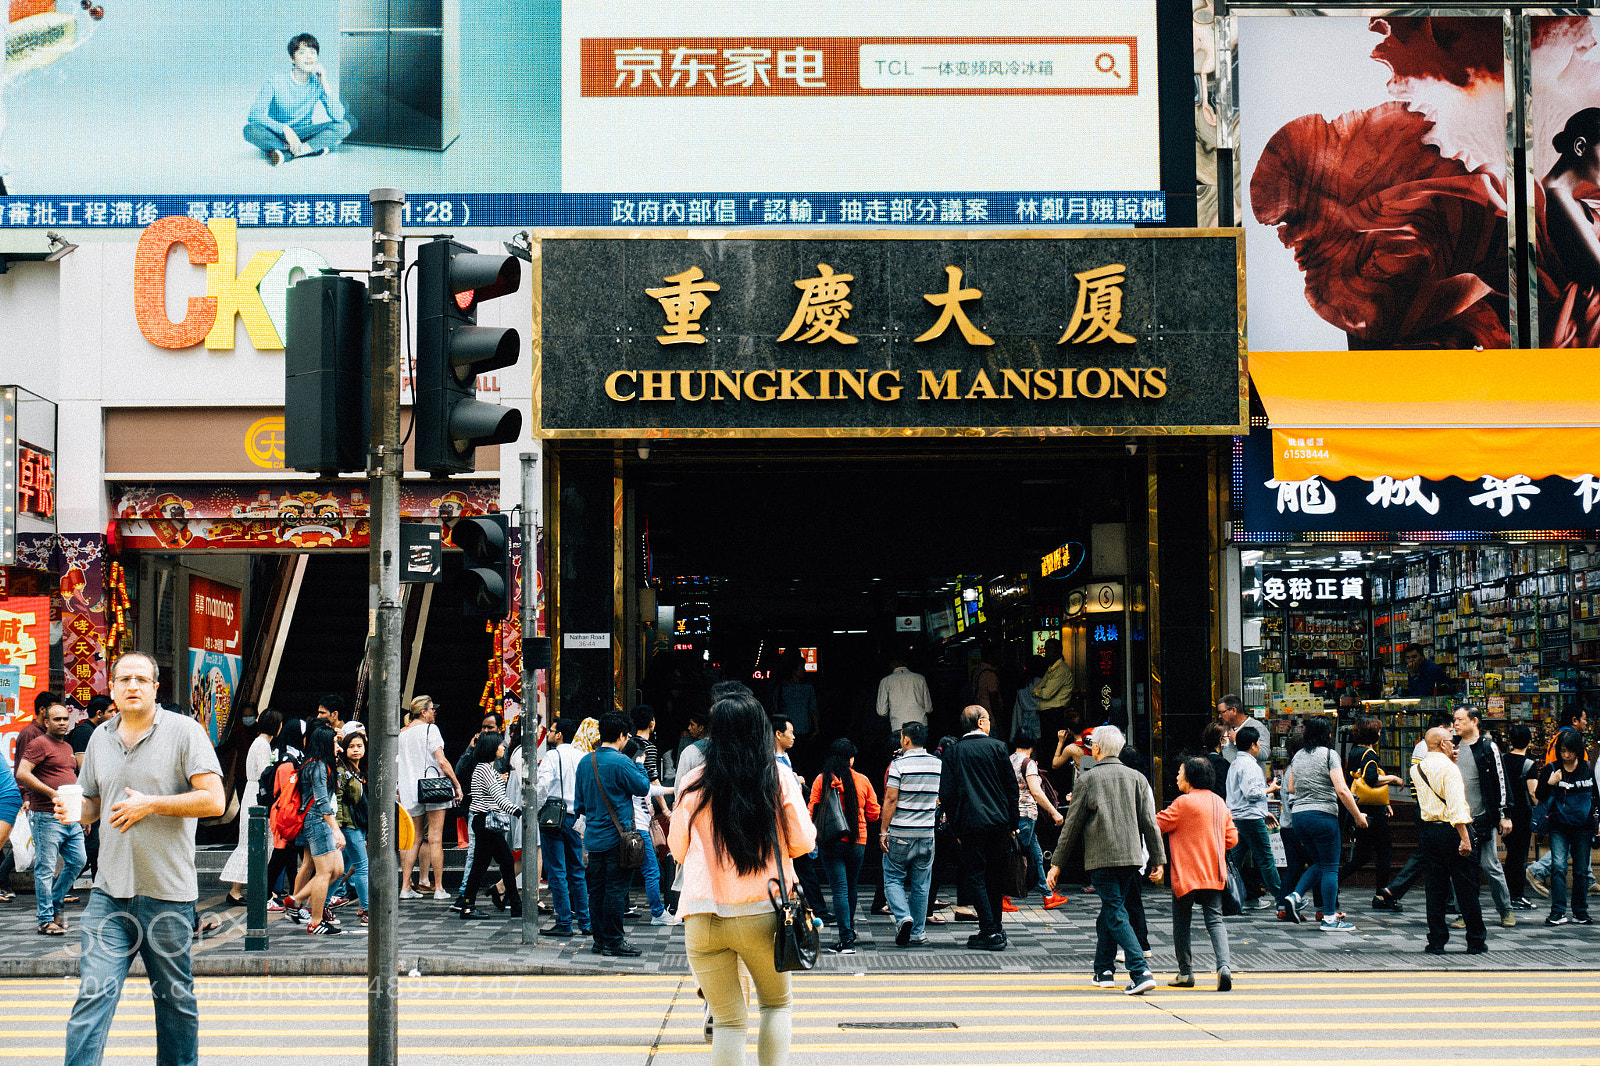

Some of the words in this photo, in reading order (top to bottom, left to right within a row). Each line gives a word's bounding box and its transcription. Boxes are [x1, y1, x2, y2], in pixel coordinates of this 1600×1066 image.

[614, 46, 827, 88] 京东家电
[874, 60, 915, 76] TCL
[604, 368, 904, 402] CHUNGKING
[917, 367, 1168, 401] MANSIONS
[1284, 450, 1329, 459] 61538444
